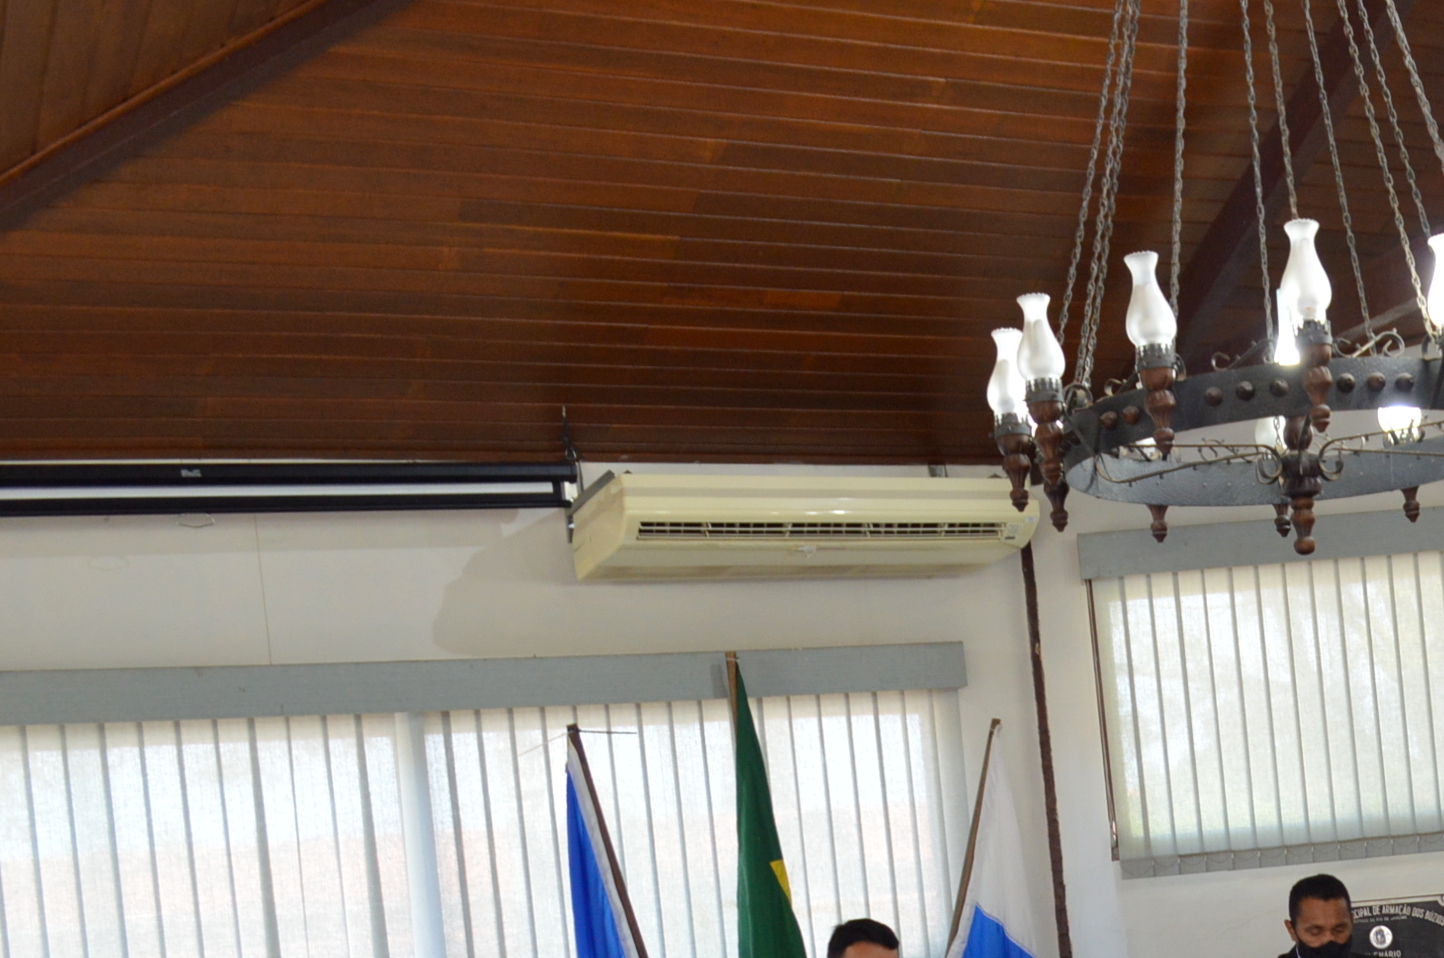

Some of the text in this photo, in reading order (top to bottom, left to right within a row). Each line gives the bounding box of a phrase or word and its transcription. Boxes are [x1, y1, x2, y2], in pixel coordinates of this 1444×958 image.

[1352, 906, 1372, 918] CIPAL
[1372, 905, 1381, 915] DE
[1382, 904, 1411, 915] ARMAÇÃO
[1412, 906, 1425, 918] DOS
[1365, 950, 1402, 958] ENÁRIO
